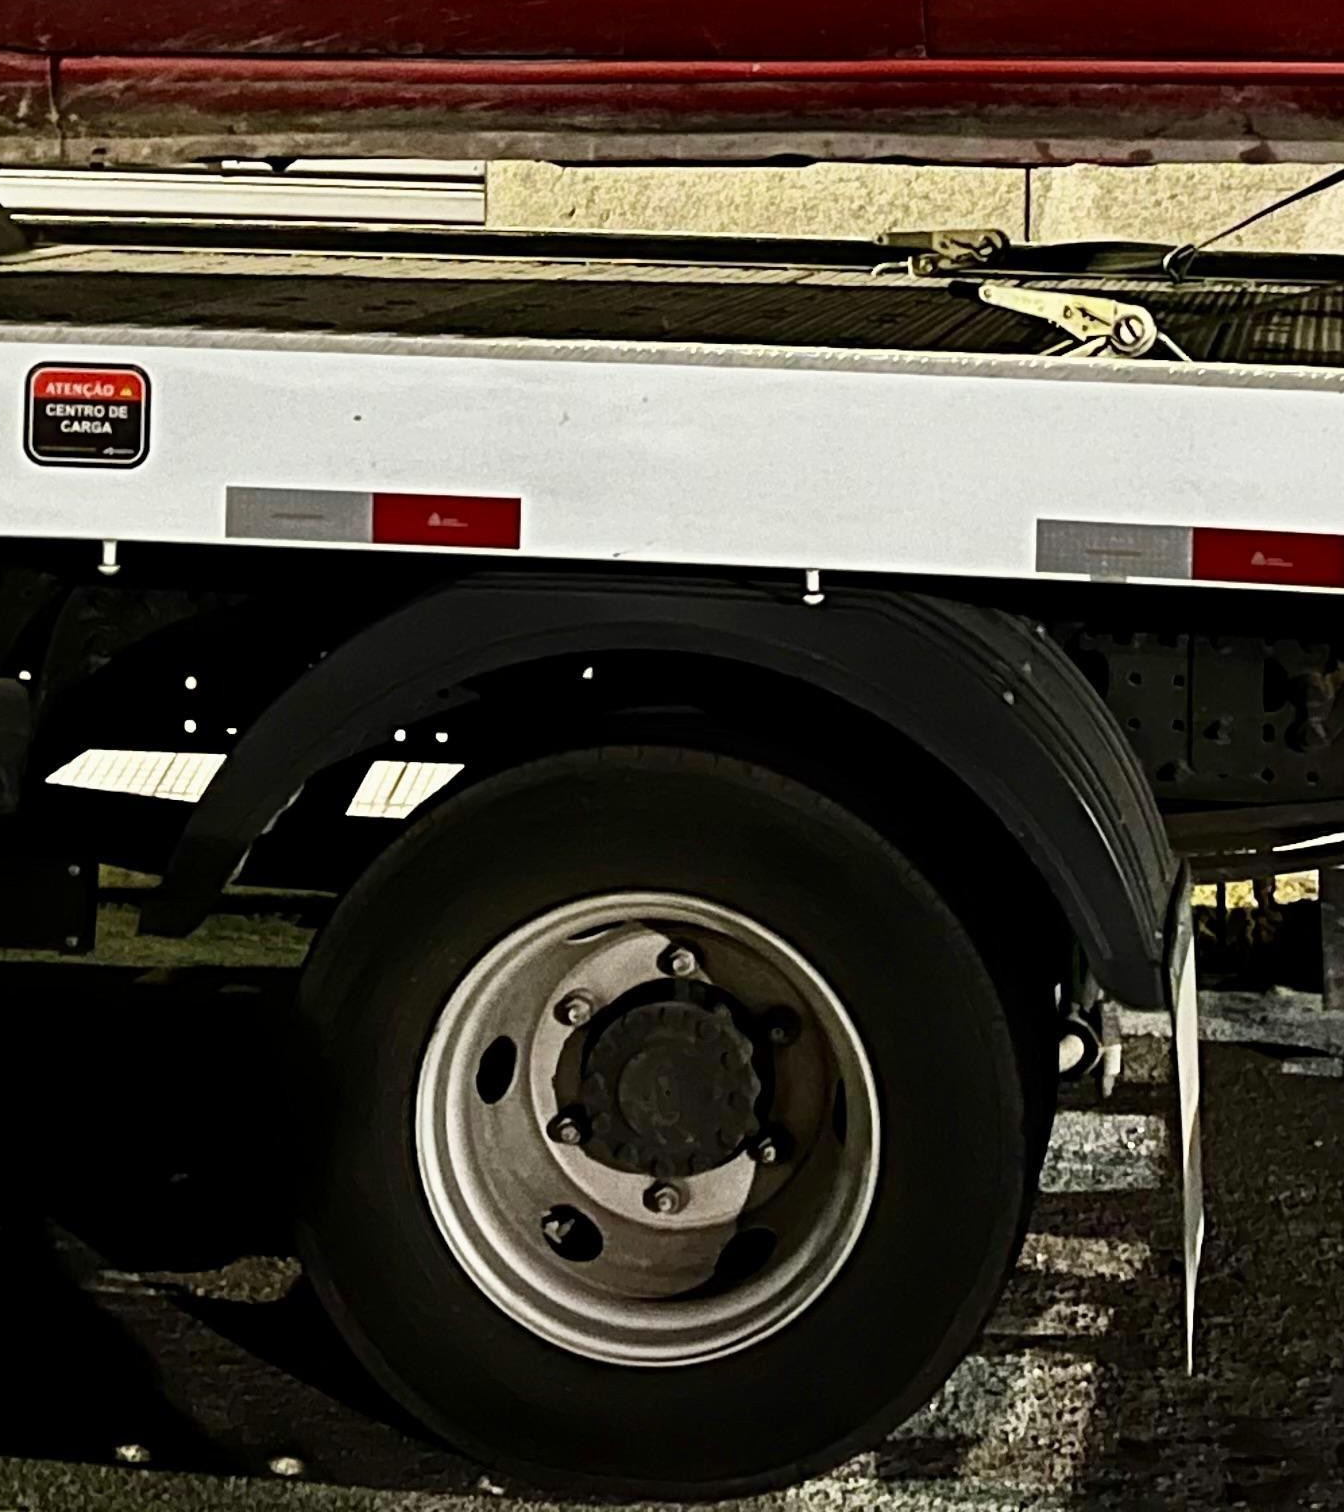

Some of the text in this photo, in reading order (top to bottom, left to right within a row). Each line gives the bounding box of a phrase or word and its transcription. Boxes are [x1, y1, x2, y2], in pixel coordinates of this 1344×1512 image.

[46, 380, 114, 399] ATENÇÃO
[46, 404, 128, 418] CENTRO DE
[61, 421, 112, 434] CARGA
